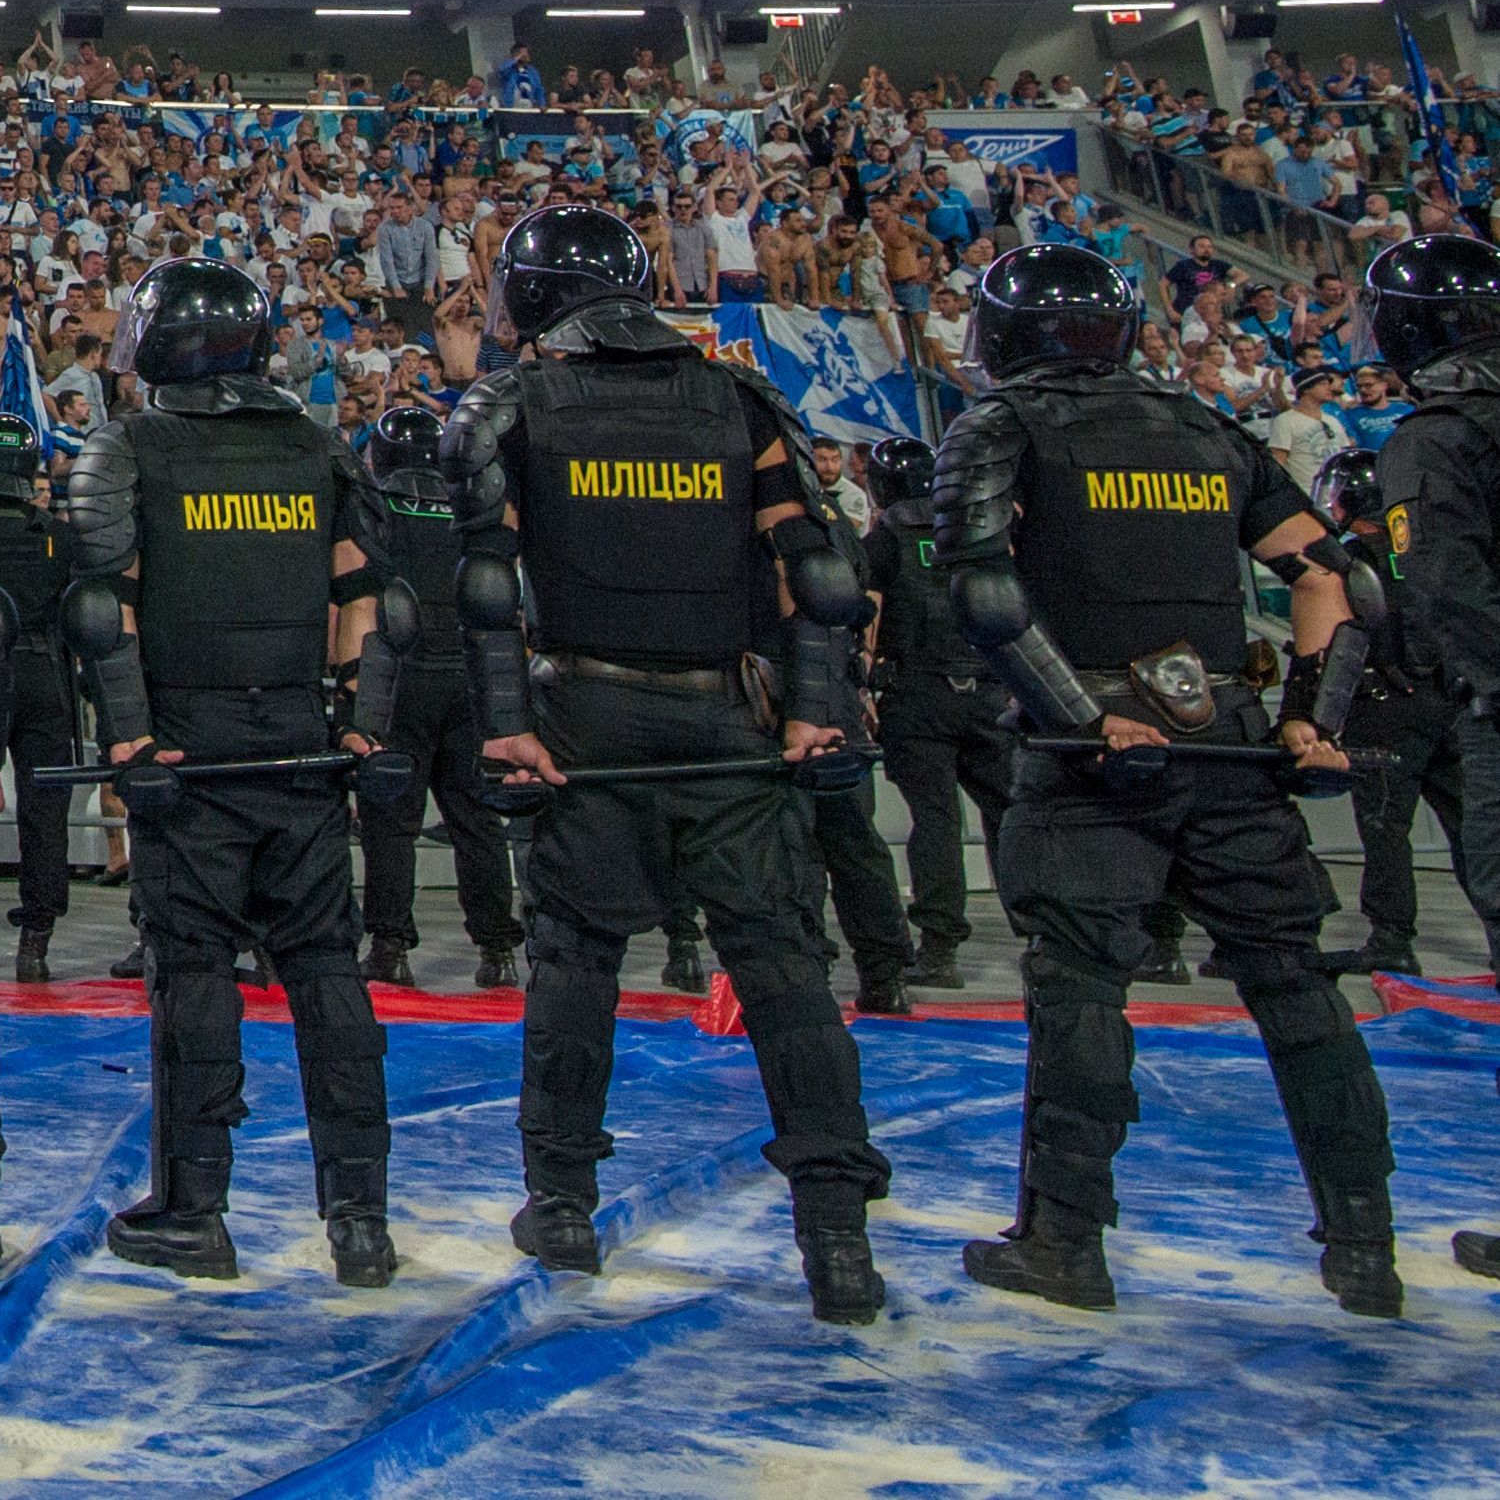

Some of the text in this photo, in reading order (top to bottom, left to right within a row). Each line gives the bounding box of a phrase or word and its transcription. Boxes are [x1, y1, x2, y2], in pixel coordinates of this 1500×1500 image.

[568, 459, 724, 501] МІЛІЦЫЯ
[1085, 471, 1231, 514] МІЛІЦЫЯ
[183, 494, 317, 533] МІЛІЦЫЯ
